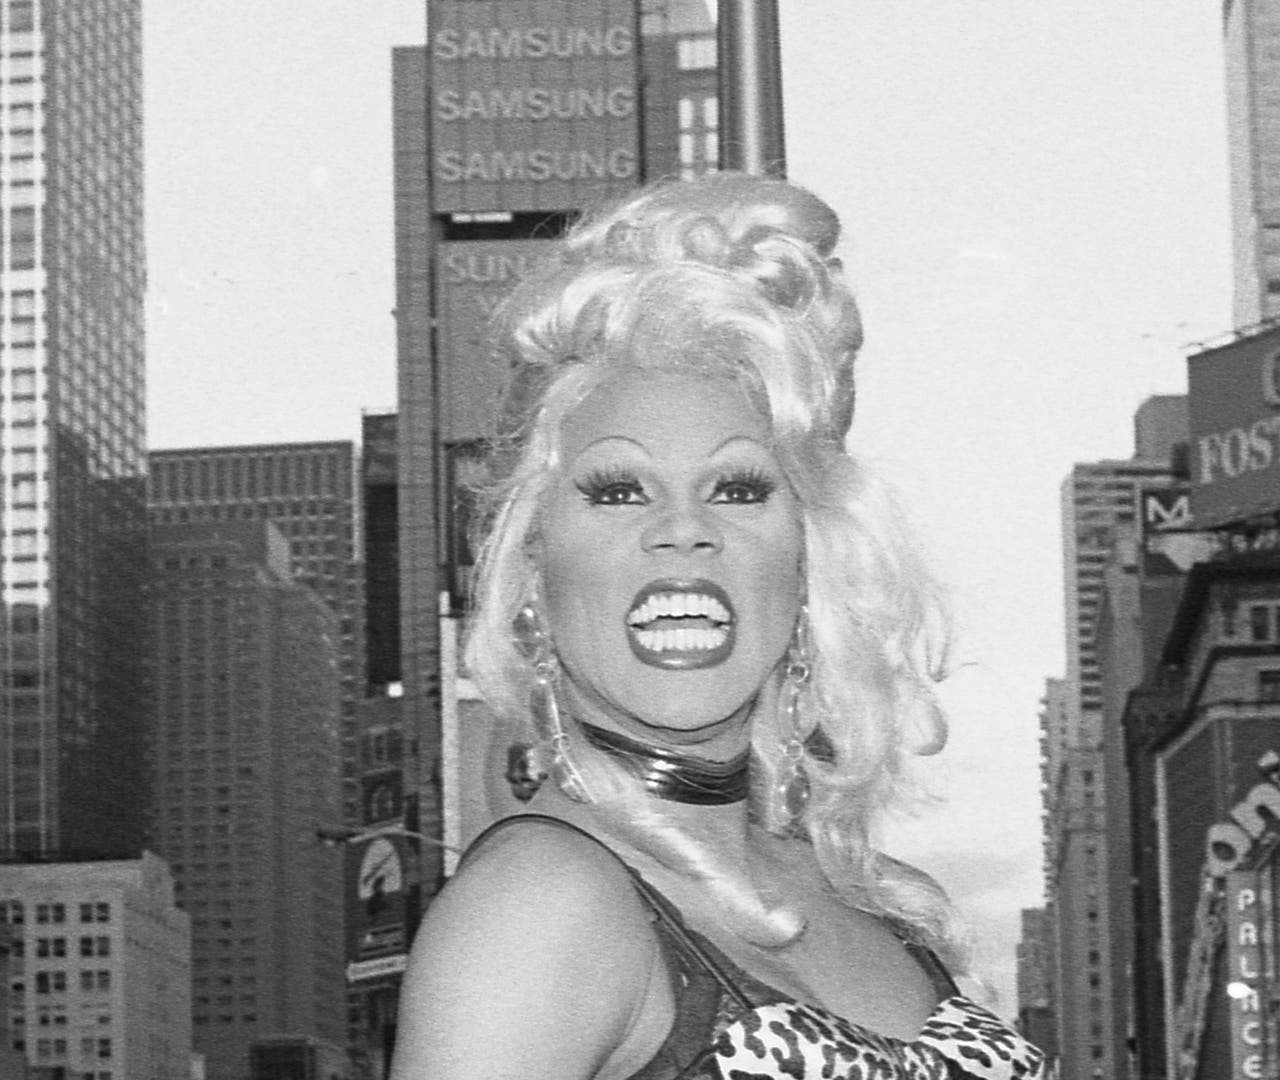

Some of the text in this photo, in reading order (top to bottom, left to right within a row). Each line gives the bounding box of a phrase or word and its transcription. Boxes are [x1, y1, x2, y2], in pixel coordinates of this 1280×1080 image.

[436, 26, 634, 58] SAMSUNG
[438, 87, 635, 119] SAMSUNG
[439, 147, 636, 180] SAMSUNG
[1236, 888, 1262, 1079] PALACE
